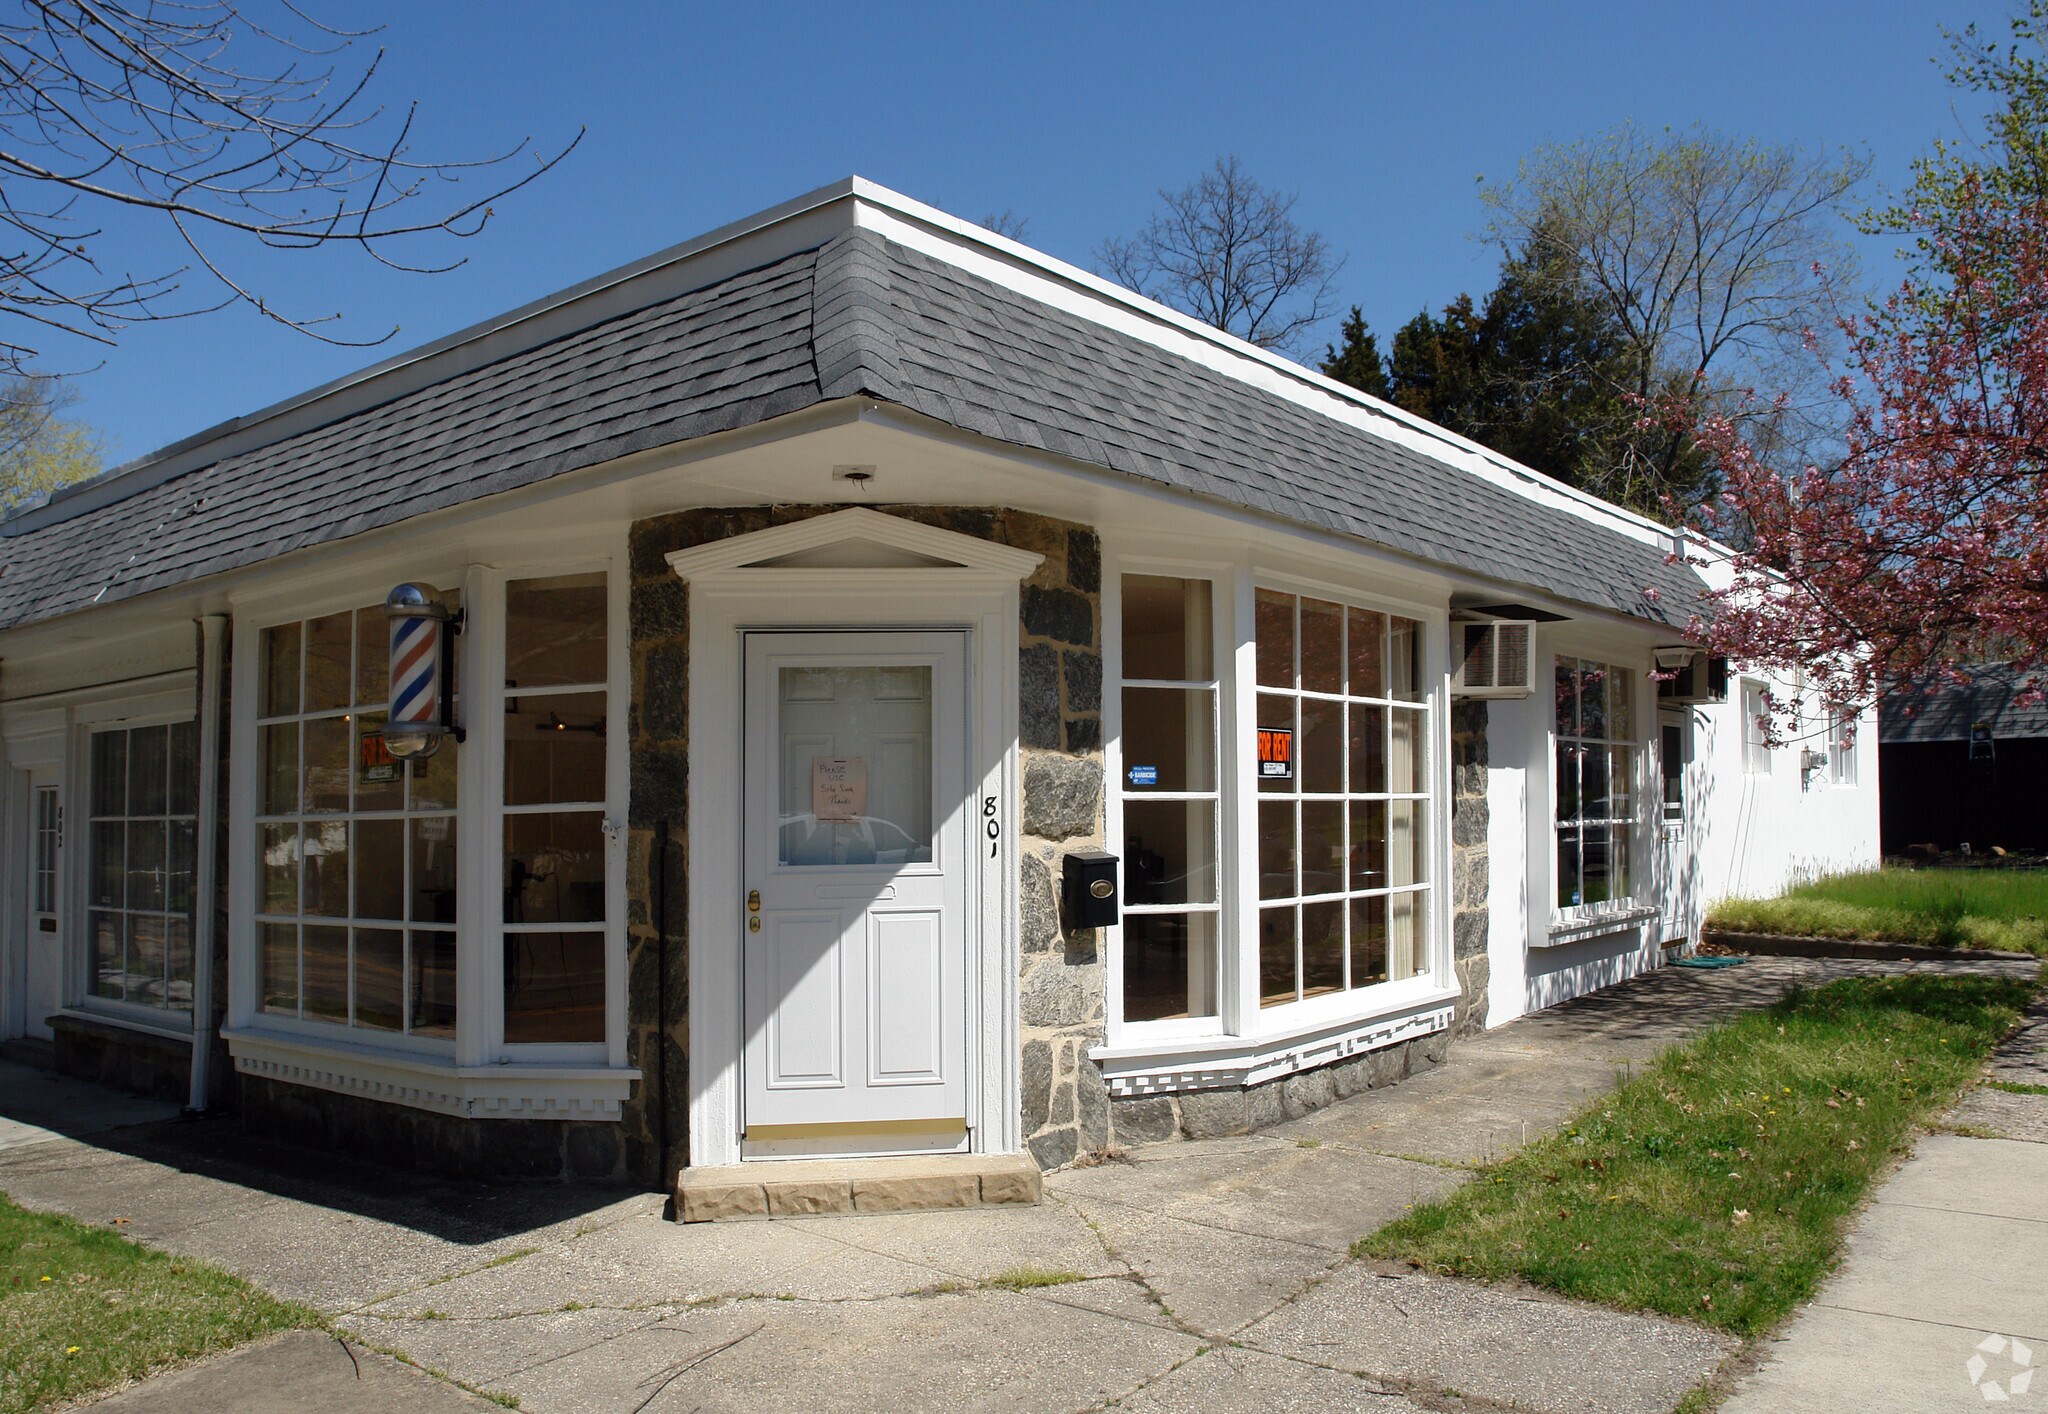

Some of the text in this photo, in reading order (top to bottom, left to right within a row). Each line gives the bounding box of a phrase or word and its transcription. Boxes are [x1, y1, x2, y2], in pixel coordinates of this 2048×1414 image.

[1258, 731, 1290, 762] FOR RENT
[983, 796, 1000, 859] 801
